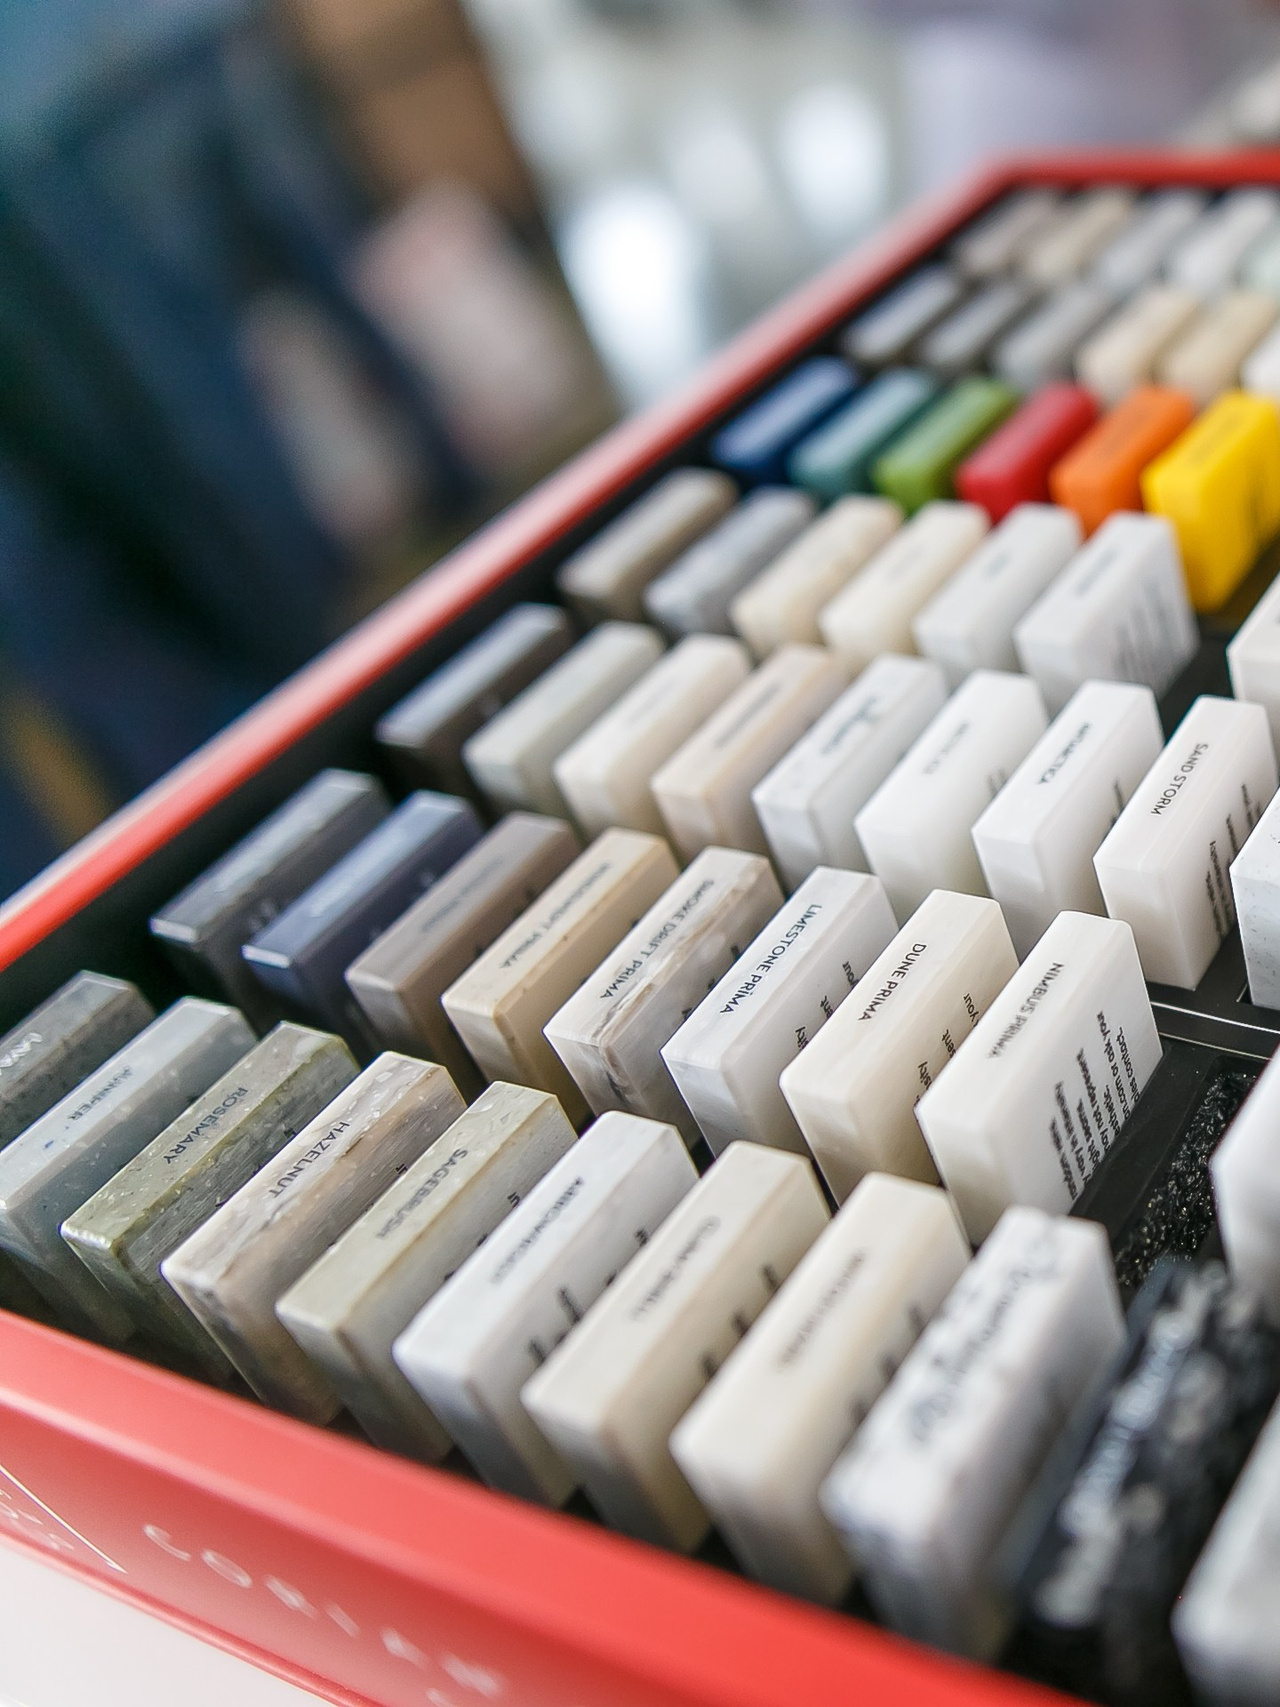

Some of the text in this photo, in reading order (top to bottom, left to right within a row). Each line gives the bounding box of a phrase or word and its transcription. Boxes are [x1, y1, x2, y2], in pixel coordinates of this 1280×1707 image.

[1151, 743, 1208, 816] SAND STORM
[640, 918, 678, 960] DRIFT
[719, 904, 822, 1014] LIMESTONE PRIMA
[600, 958, 643, 1000] PRIMA
[858, 943, 927, 1022] DUNE PRIMA
[986, 962, 1065, 1058] NIMBUS PRIMA
[1098, 1011, 1110, 1040] your
[1104, 1038, 1115, 1062] ask
[1110, 1062, 1118, 1077] or
[1117, 1026, 1133, 1078] contact.
[67, 1066, 133, 1122] JUNIPER
[1093, 1105, 1103, 1130] not
[163, 1087, 249, 1165] ROSEMARY
[268, 1121, 351, 1198] HAZELNUT
[375, 1149, 468, 1239] SAGEBRUSH
